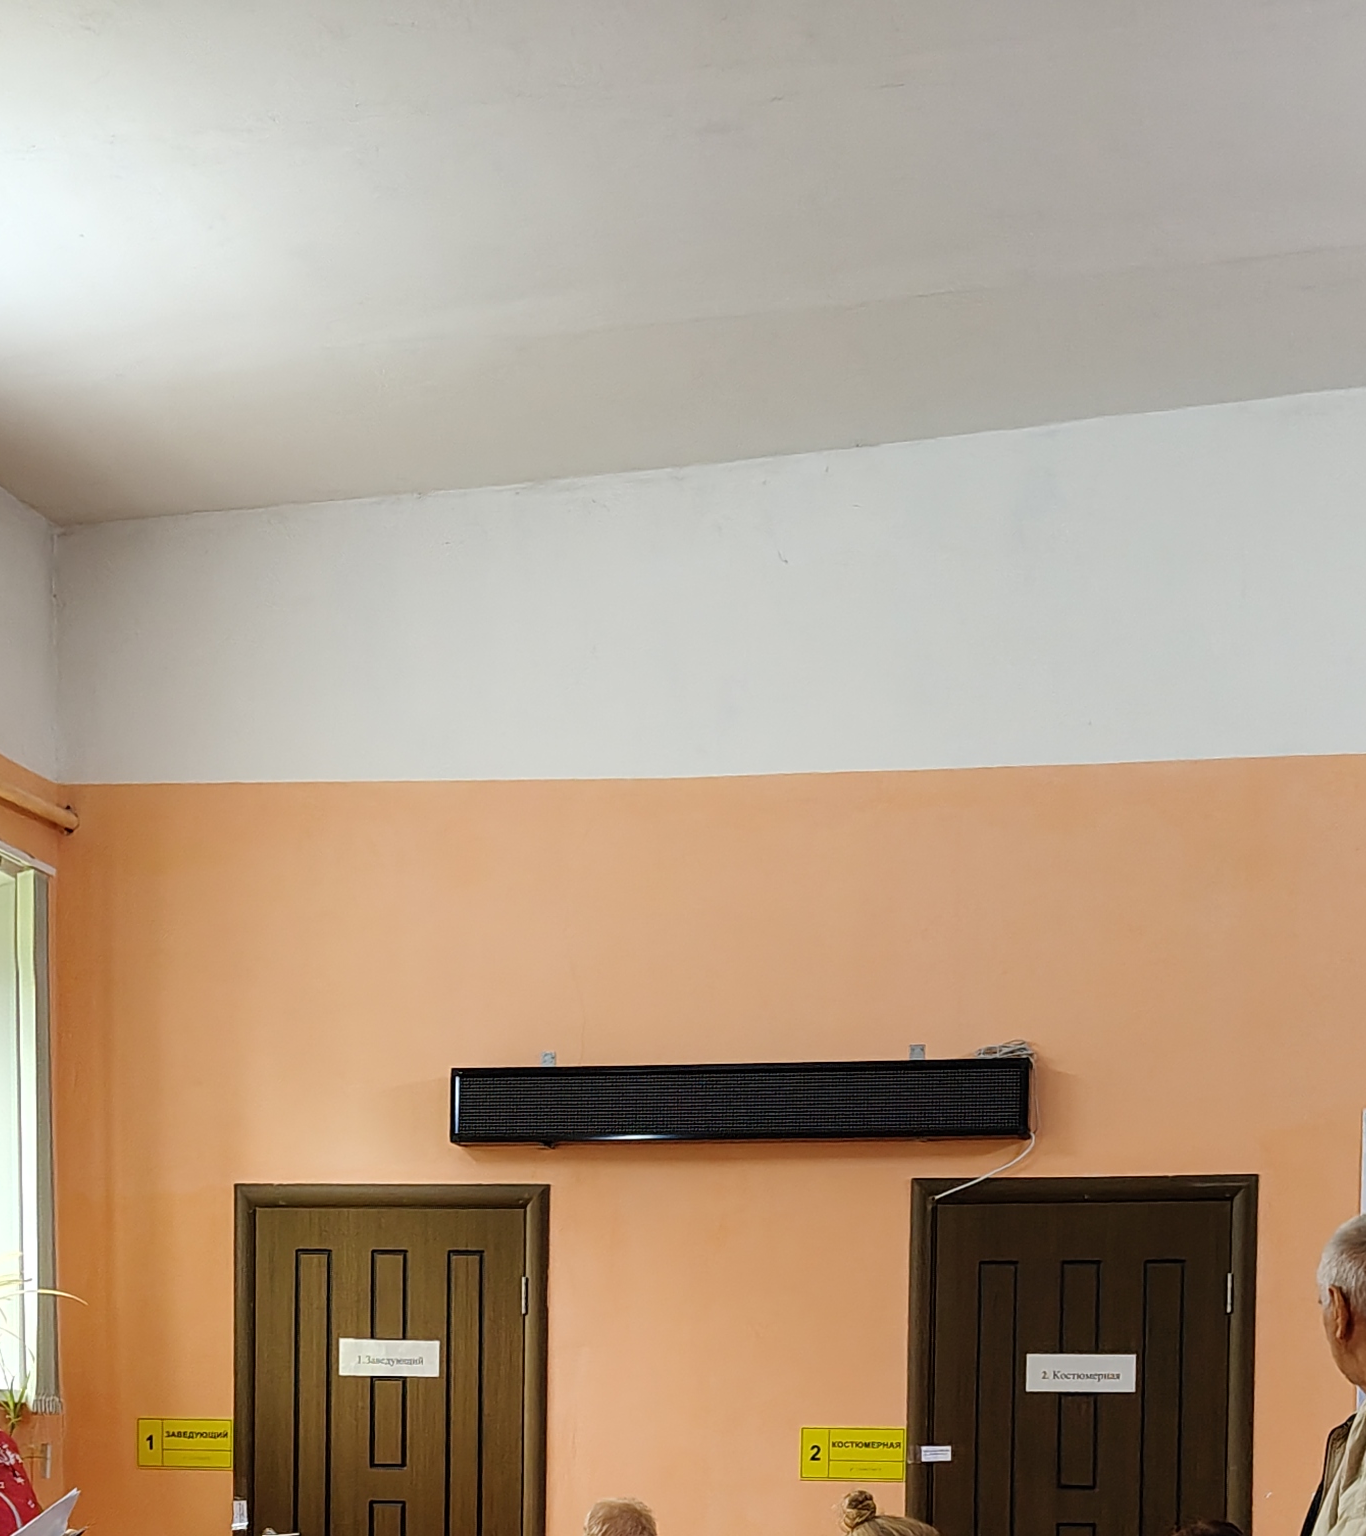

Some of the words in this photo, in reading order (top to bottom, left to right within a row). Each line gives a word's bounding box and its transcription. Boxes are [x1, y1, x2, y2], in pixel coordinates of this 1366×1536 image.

[1053, 1370, 1121, 1382] Костюмерная
[164, 1430, 228, 1439] ЗАВЕДУЮЩИЙ
[146, 1434, 153, 1450] 1
[832, 1441, 901, 1449] КОСТЮМЕРНАЯ
[809, 1445, 821, 1461] 2
